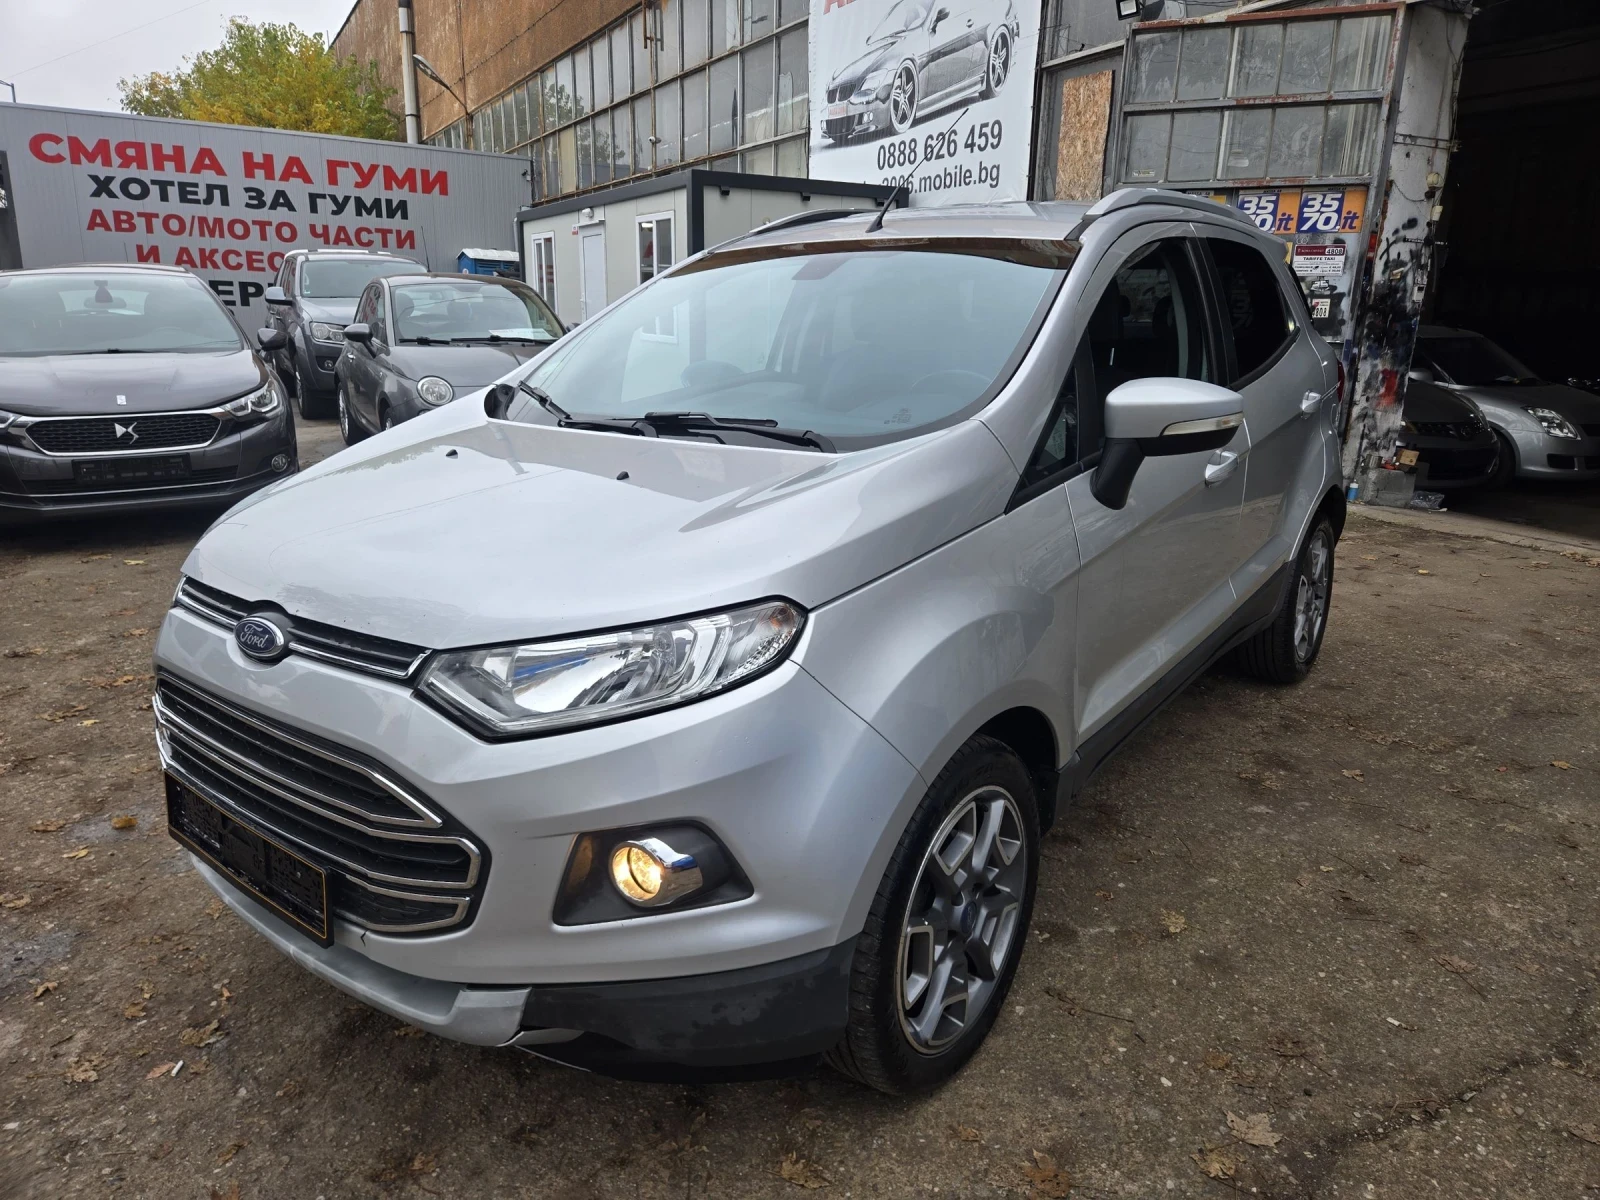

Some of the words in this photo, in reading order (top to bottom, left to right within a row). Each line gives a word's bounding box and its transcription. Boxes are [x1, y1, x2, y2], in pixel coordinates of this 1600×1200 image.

[877, 137, 918, 170] 0888
[923, 128, 958, 162] 626
[963, 119, 1003, 154] 459
[28, 133, 228, 177] СМЯНА
[242, 151, 315, 185] НА
[326, 159, 449, 196] ГУМИ
[89, 174, 230, 207] ХОТЕЛ
[243, 186, 298, 213] ЗА
[307, 192, 409, 220] ГУМИ
[1243, 195, 1277, 215] 35
[1303, 193, 1343, 212] 35
[86, 208, 298, 243] АВТО/МОТО
[309, 224, 416, 250] ЧАСТИ
[136, 243, 161, 264] И
[240, 623, 269, 649] Ford
